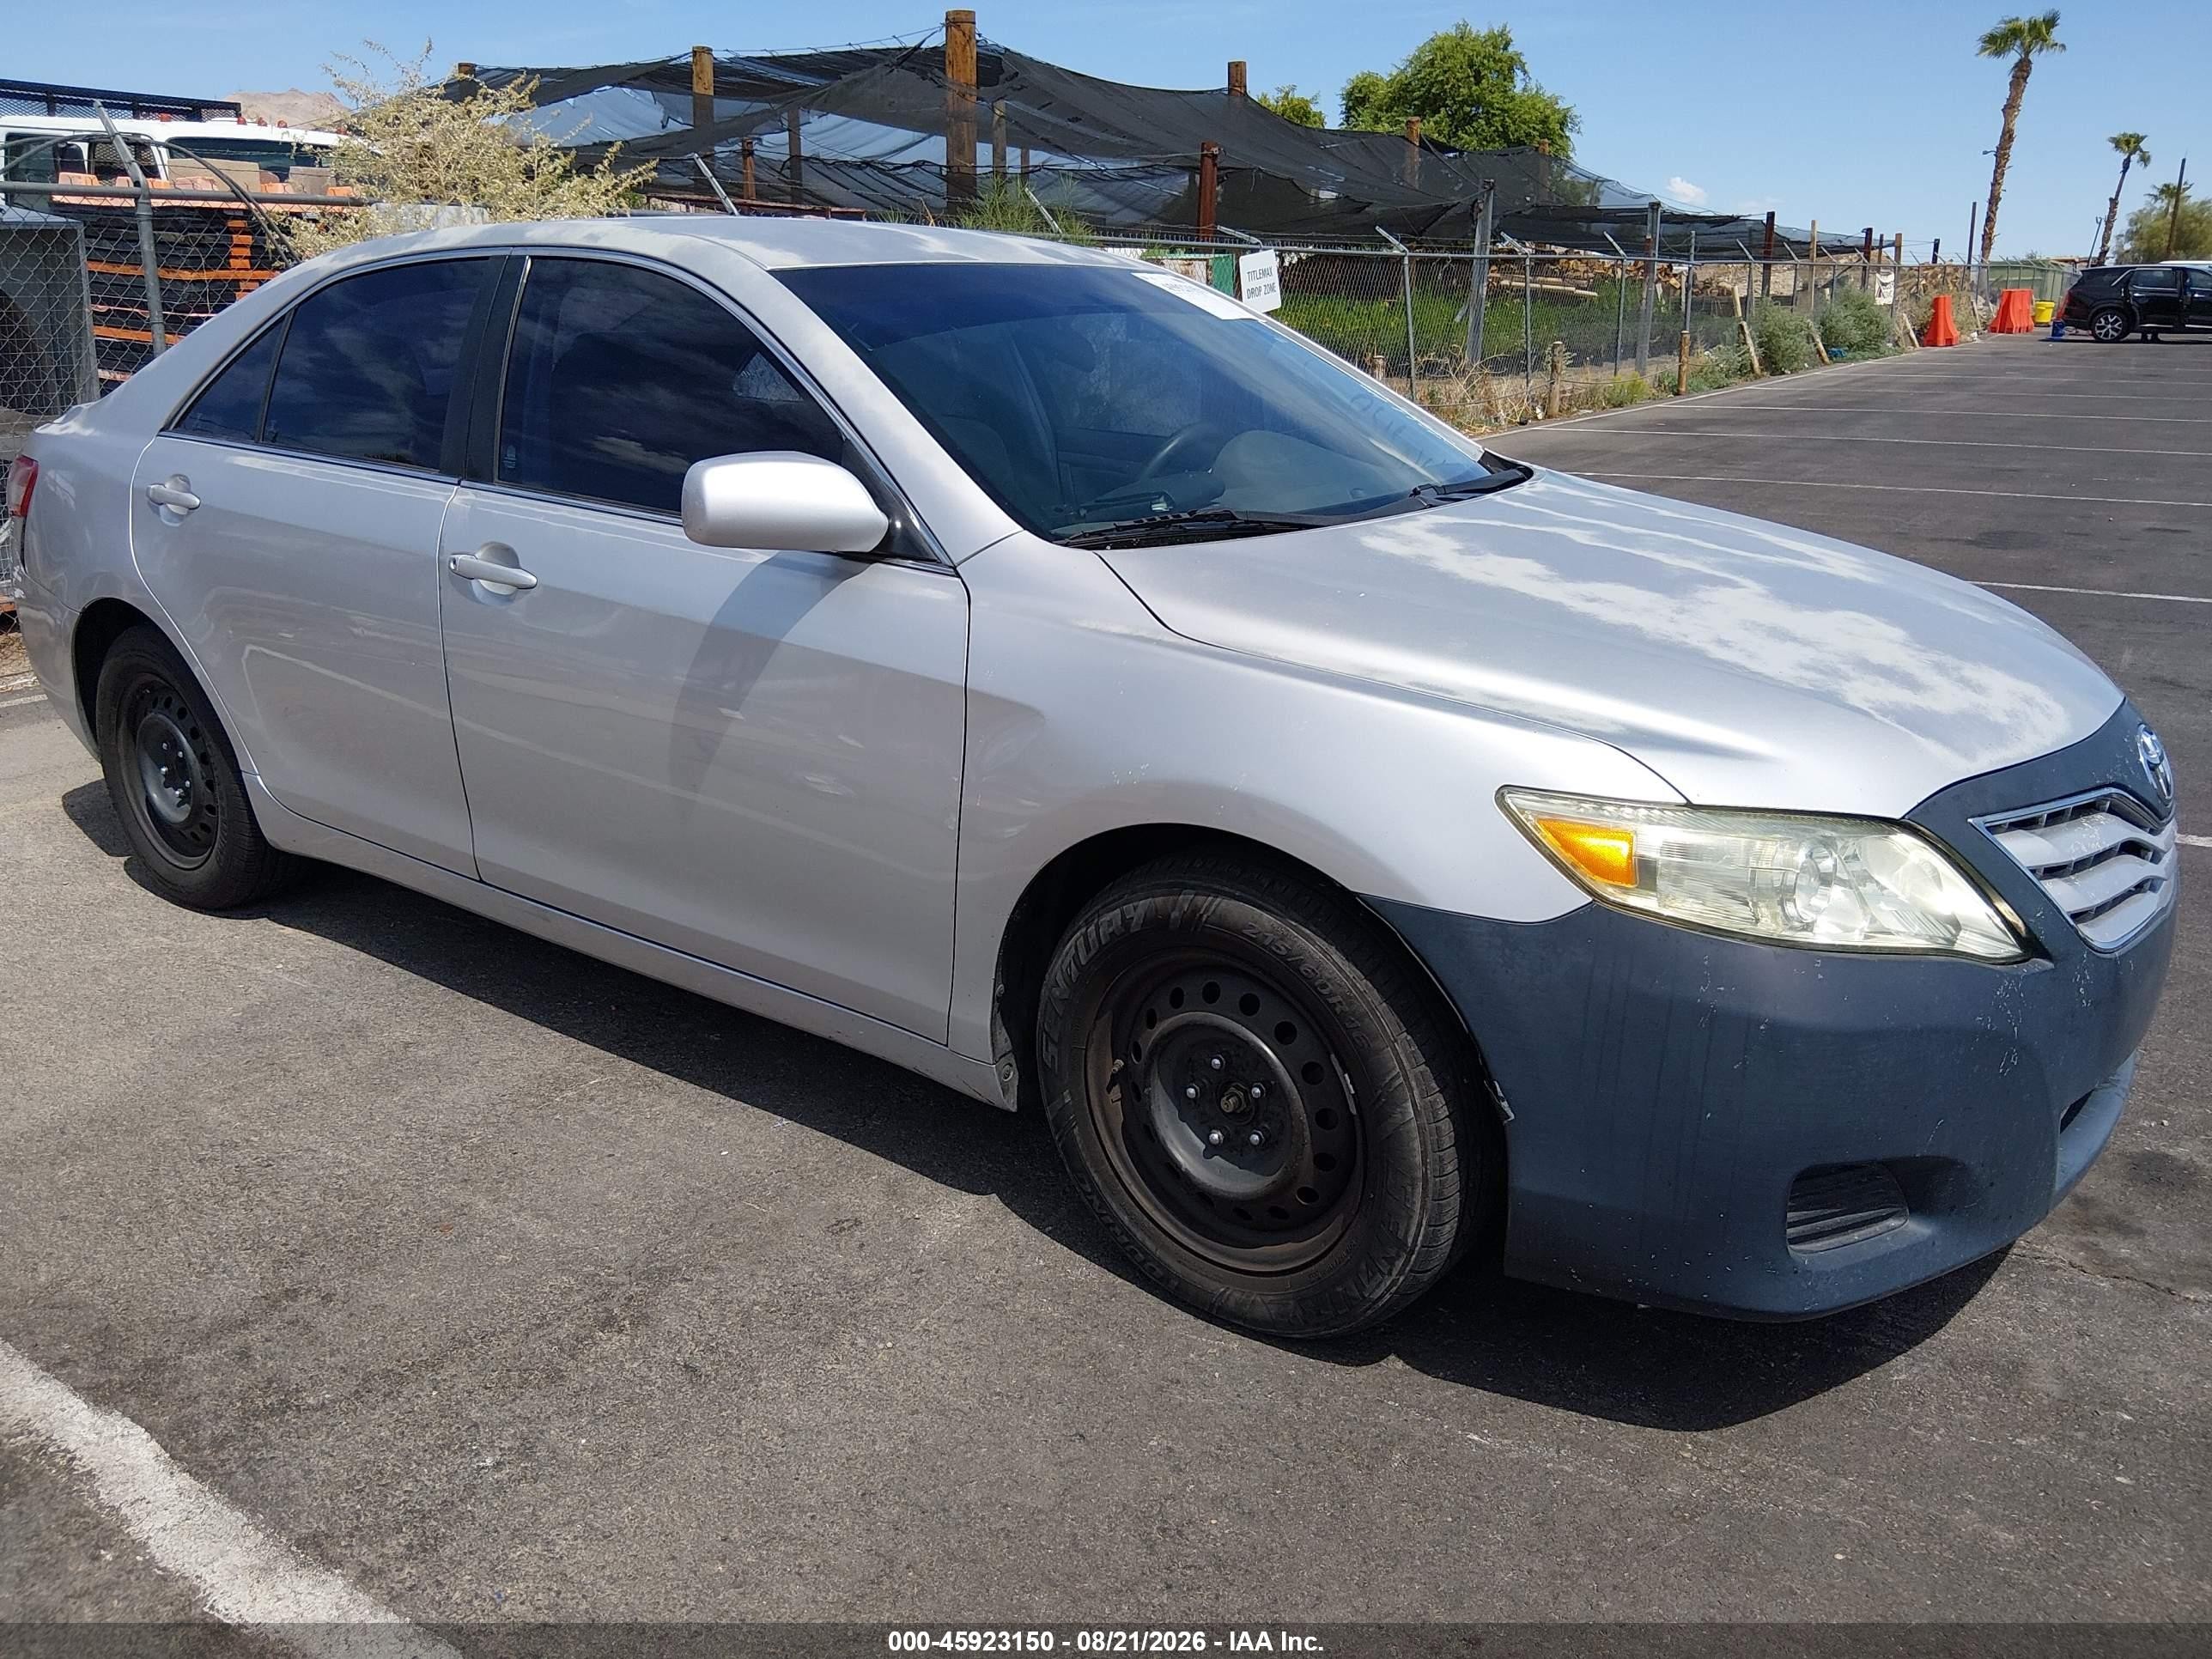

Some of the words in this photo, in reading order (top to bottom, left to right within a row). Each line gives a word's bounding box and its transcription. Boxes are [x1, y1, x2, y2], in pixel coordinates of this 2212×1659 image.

[1247, 266, 1273, 282] TITLEMAX
[1247, 287, 1262, 300] DROP
[1264, 283, 1277, 295] ZONE
